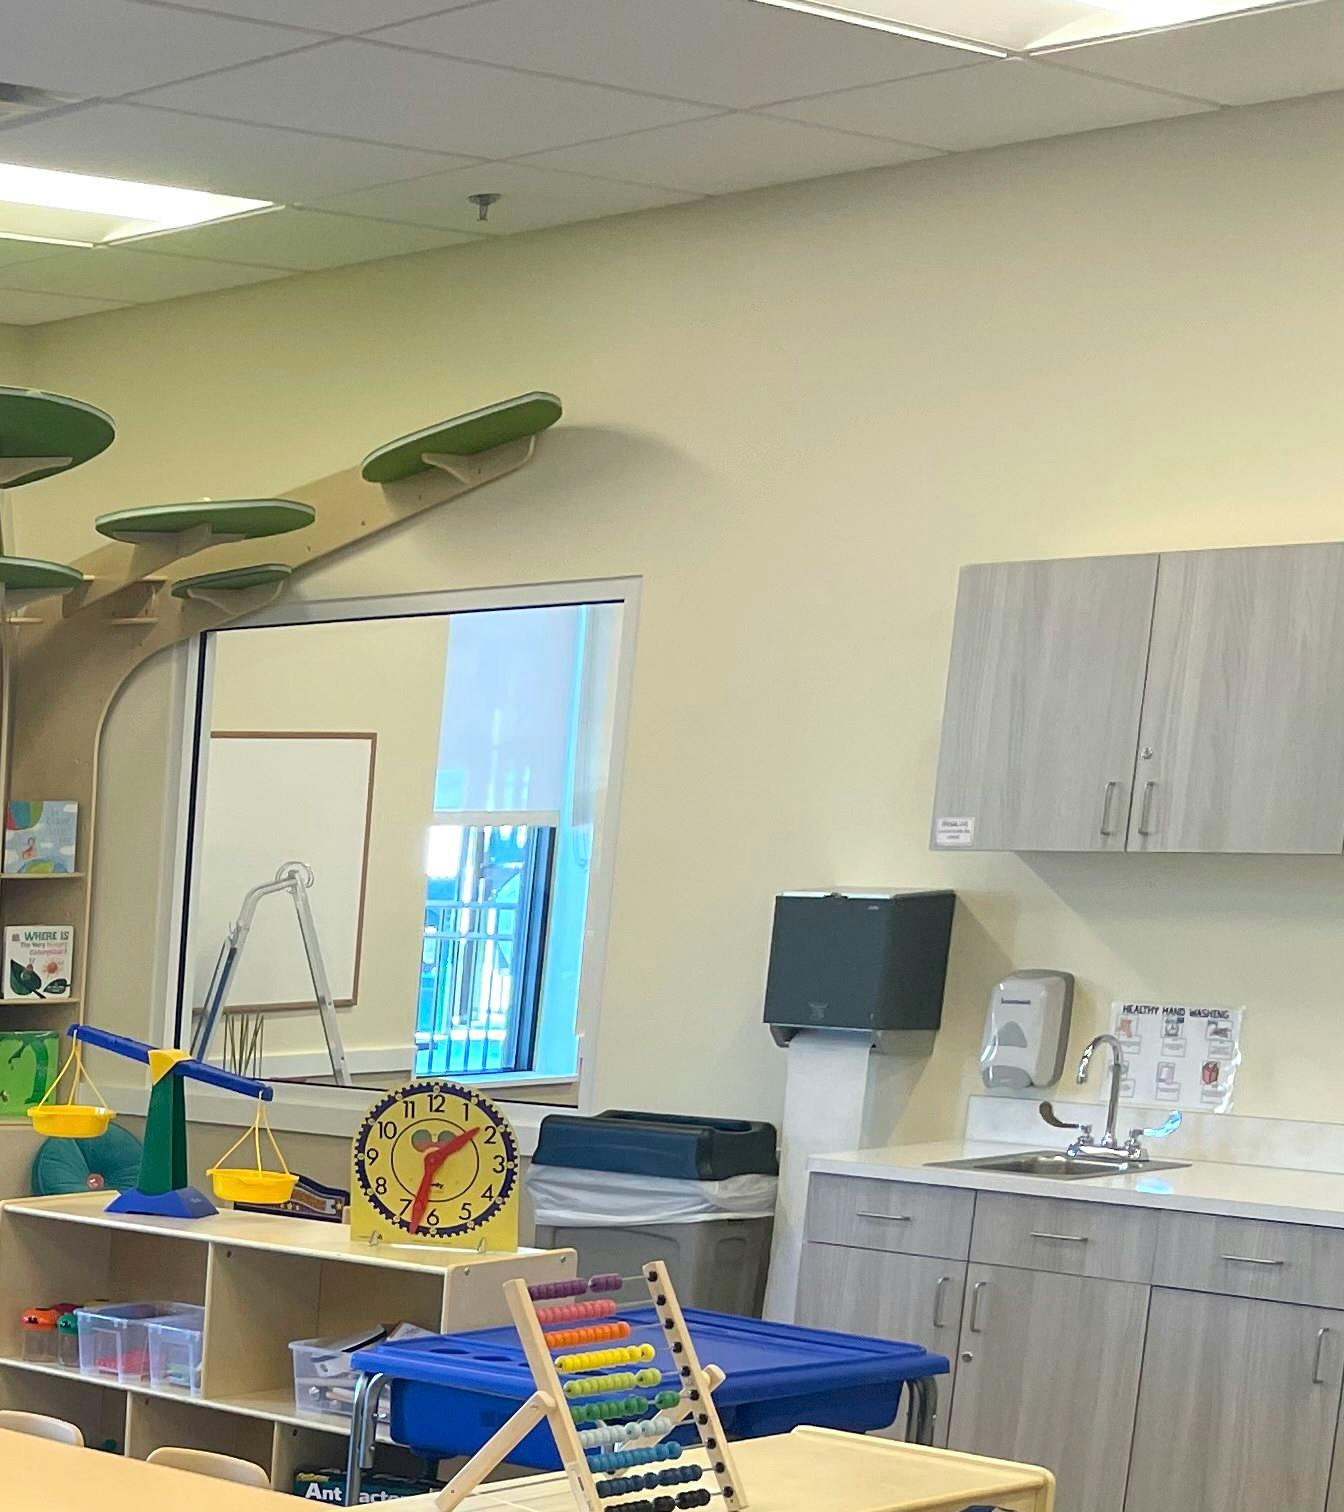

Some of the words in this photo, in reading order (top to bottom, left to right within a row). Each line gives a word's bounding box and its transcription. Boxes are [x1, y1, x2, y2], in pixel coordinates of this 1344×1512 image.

[24, 931, 57, 941] WHERE
[60, 931, 70, 941] IS
[1122, 1004, 1160, 1016] HEALTHY
[1162, 1007, 1186, 1017] HAND
[1189, 1008, 1230, 1019] WASHING
[403, 1101, 415, 1119] 11
[427, 1094, 445, 1113] 12
[462, 1103, 469, 1121] 1
[378, 1121, 397, 1140] 10
[484, 1126, 497, 1144] 2
[366, 1148, 379, 1165] 9
[493, 1155, 505, 1173] 3
[375, 1177, 387, 1195] 8
[481, 1184, 494, 1202] 4
[399, 1199, 412, 1217] 7
[458, 1203, 472, 1221] 5
[426, 1209, 439, 1226] 6
[305, 1482, 343, 1502] Ant
